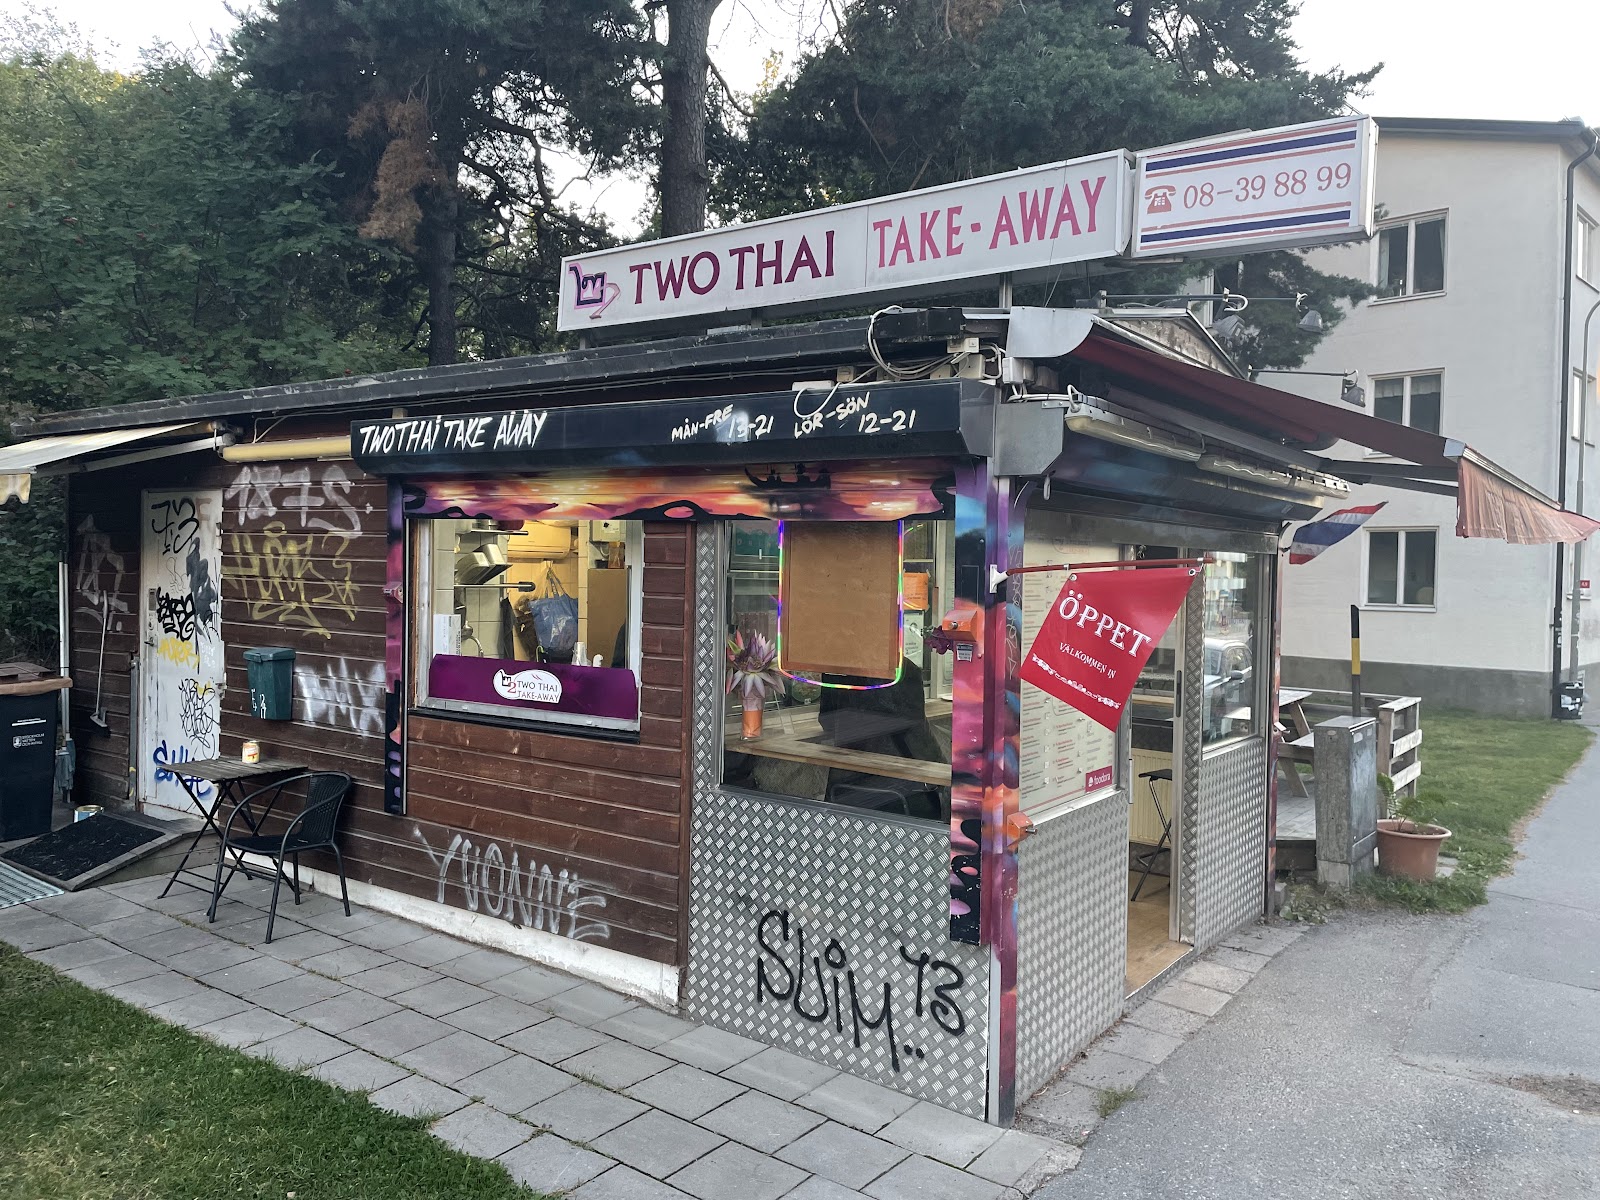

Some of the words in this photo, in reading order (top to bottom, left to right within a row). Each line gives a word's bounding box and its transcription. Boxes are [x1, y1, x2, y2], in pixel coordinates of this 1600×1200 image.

[1274, 169, 1308, 198] 88
[1316, 162, 1352, 191] 99
[629, 251, 720, 304] TWO
[729, 230, 835, 290] THAI
[444, 417, 493, 450] TAKE
[494, 409, 548, 450] AWAY
[858, 409, 916, 434] 12-21
[1059, 589, 1152, 658] ÖPPET
[517, 680, 536, 689] TWO
[538, 682, 558, 692] THAI
[1107, 668, 1117, 679] IN
[517, 690, 559, 702] TAKE-AWAY
[1094, 773, 1111, 785] foodora
